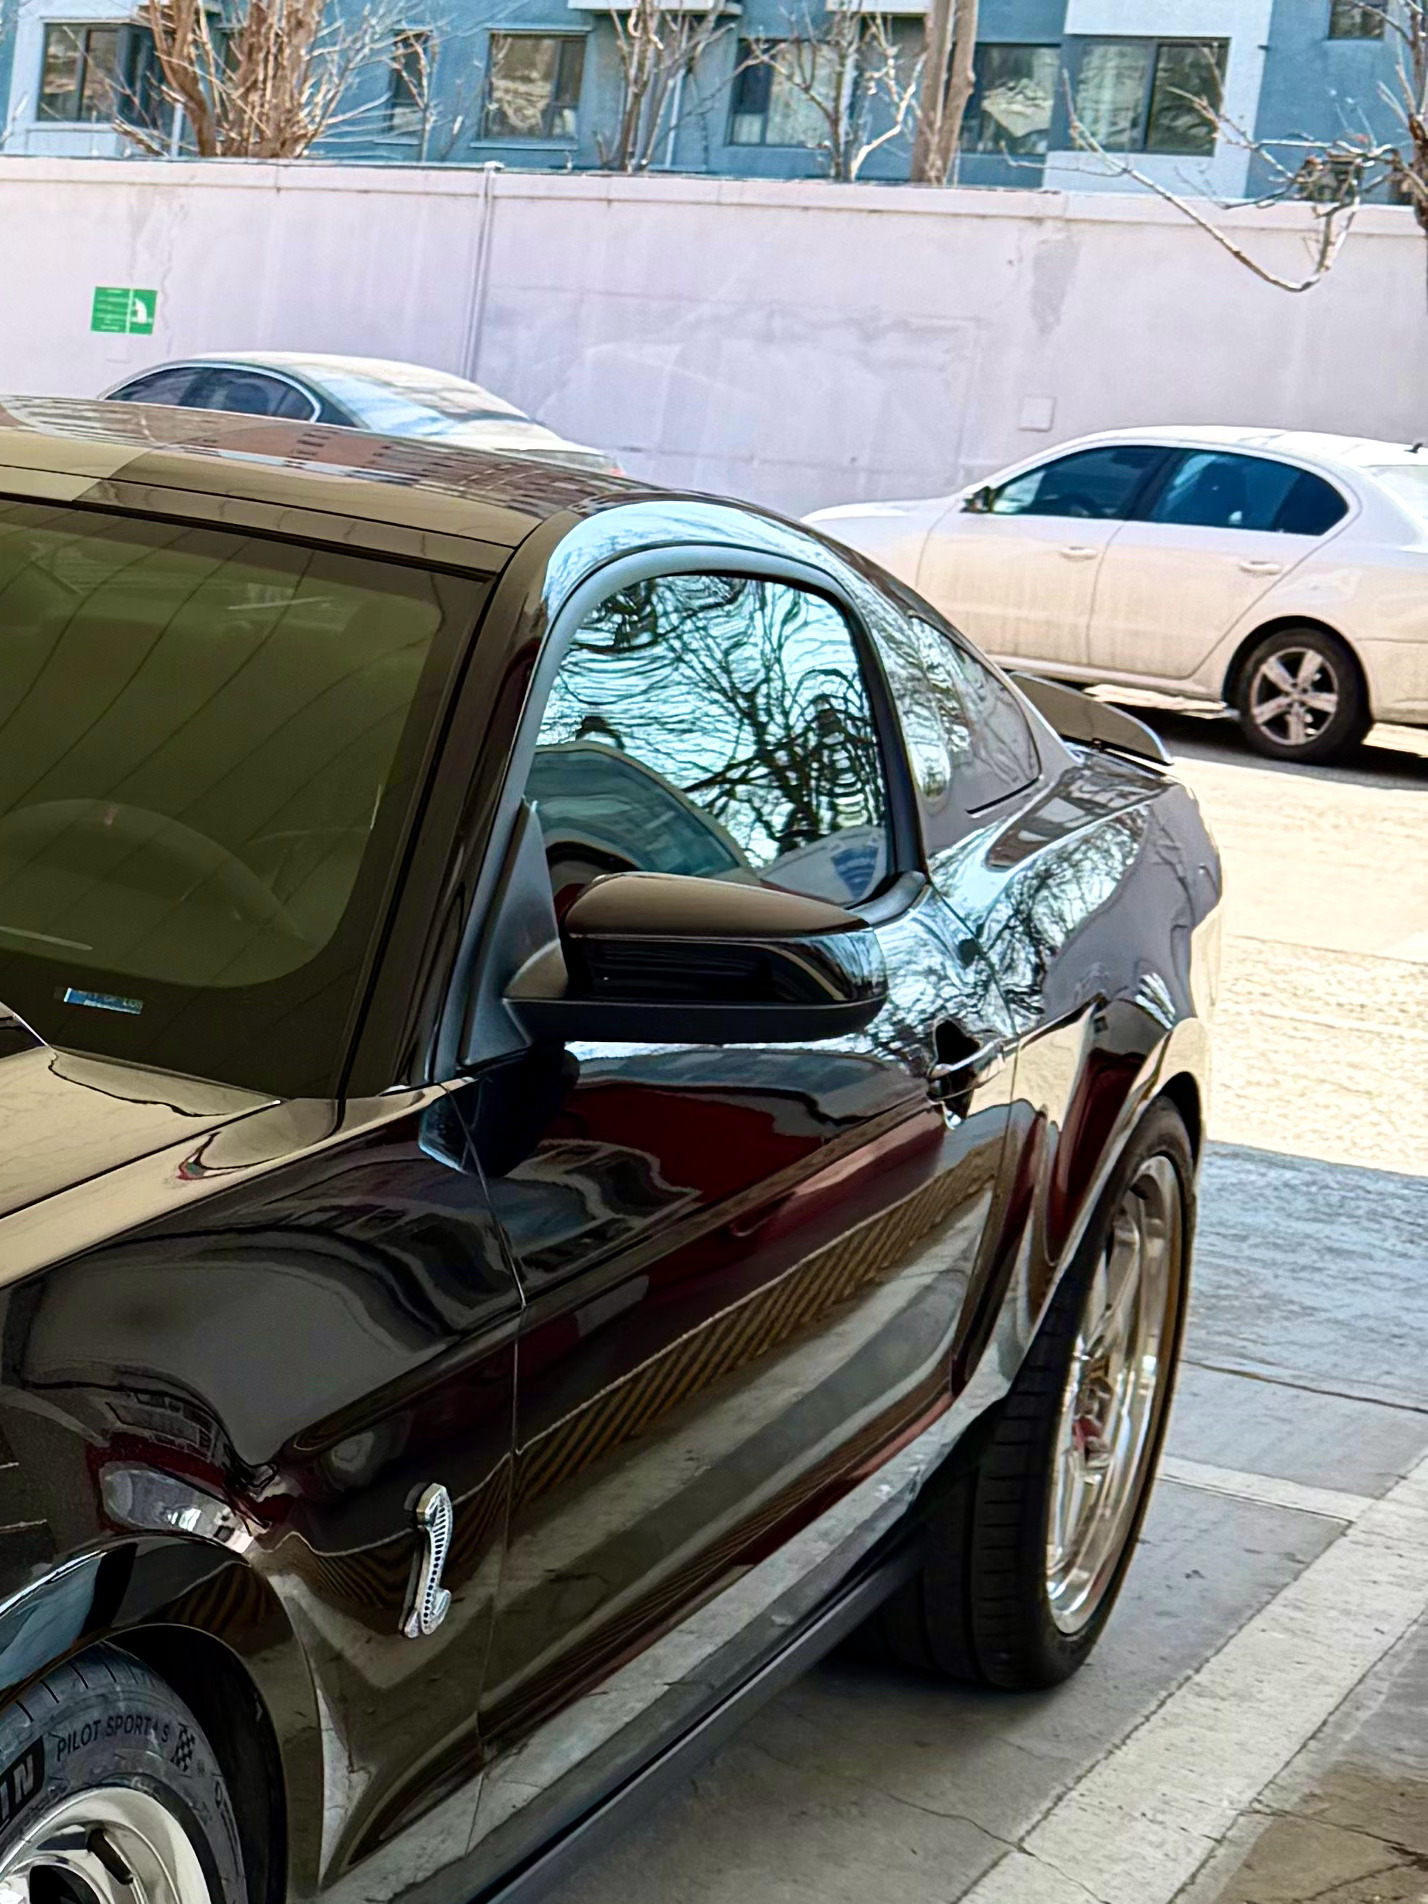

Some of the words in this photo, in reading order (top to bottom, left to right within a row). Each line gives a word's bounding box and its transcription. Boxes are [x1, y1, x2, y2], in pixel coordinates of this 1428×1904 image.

[56, 1719, 102, 1762] PILOT
[105, 1714, 151, 1737] SPORT
[161, 1724, 171, 1743] S
